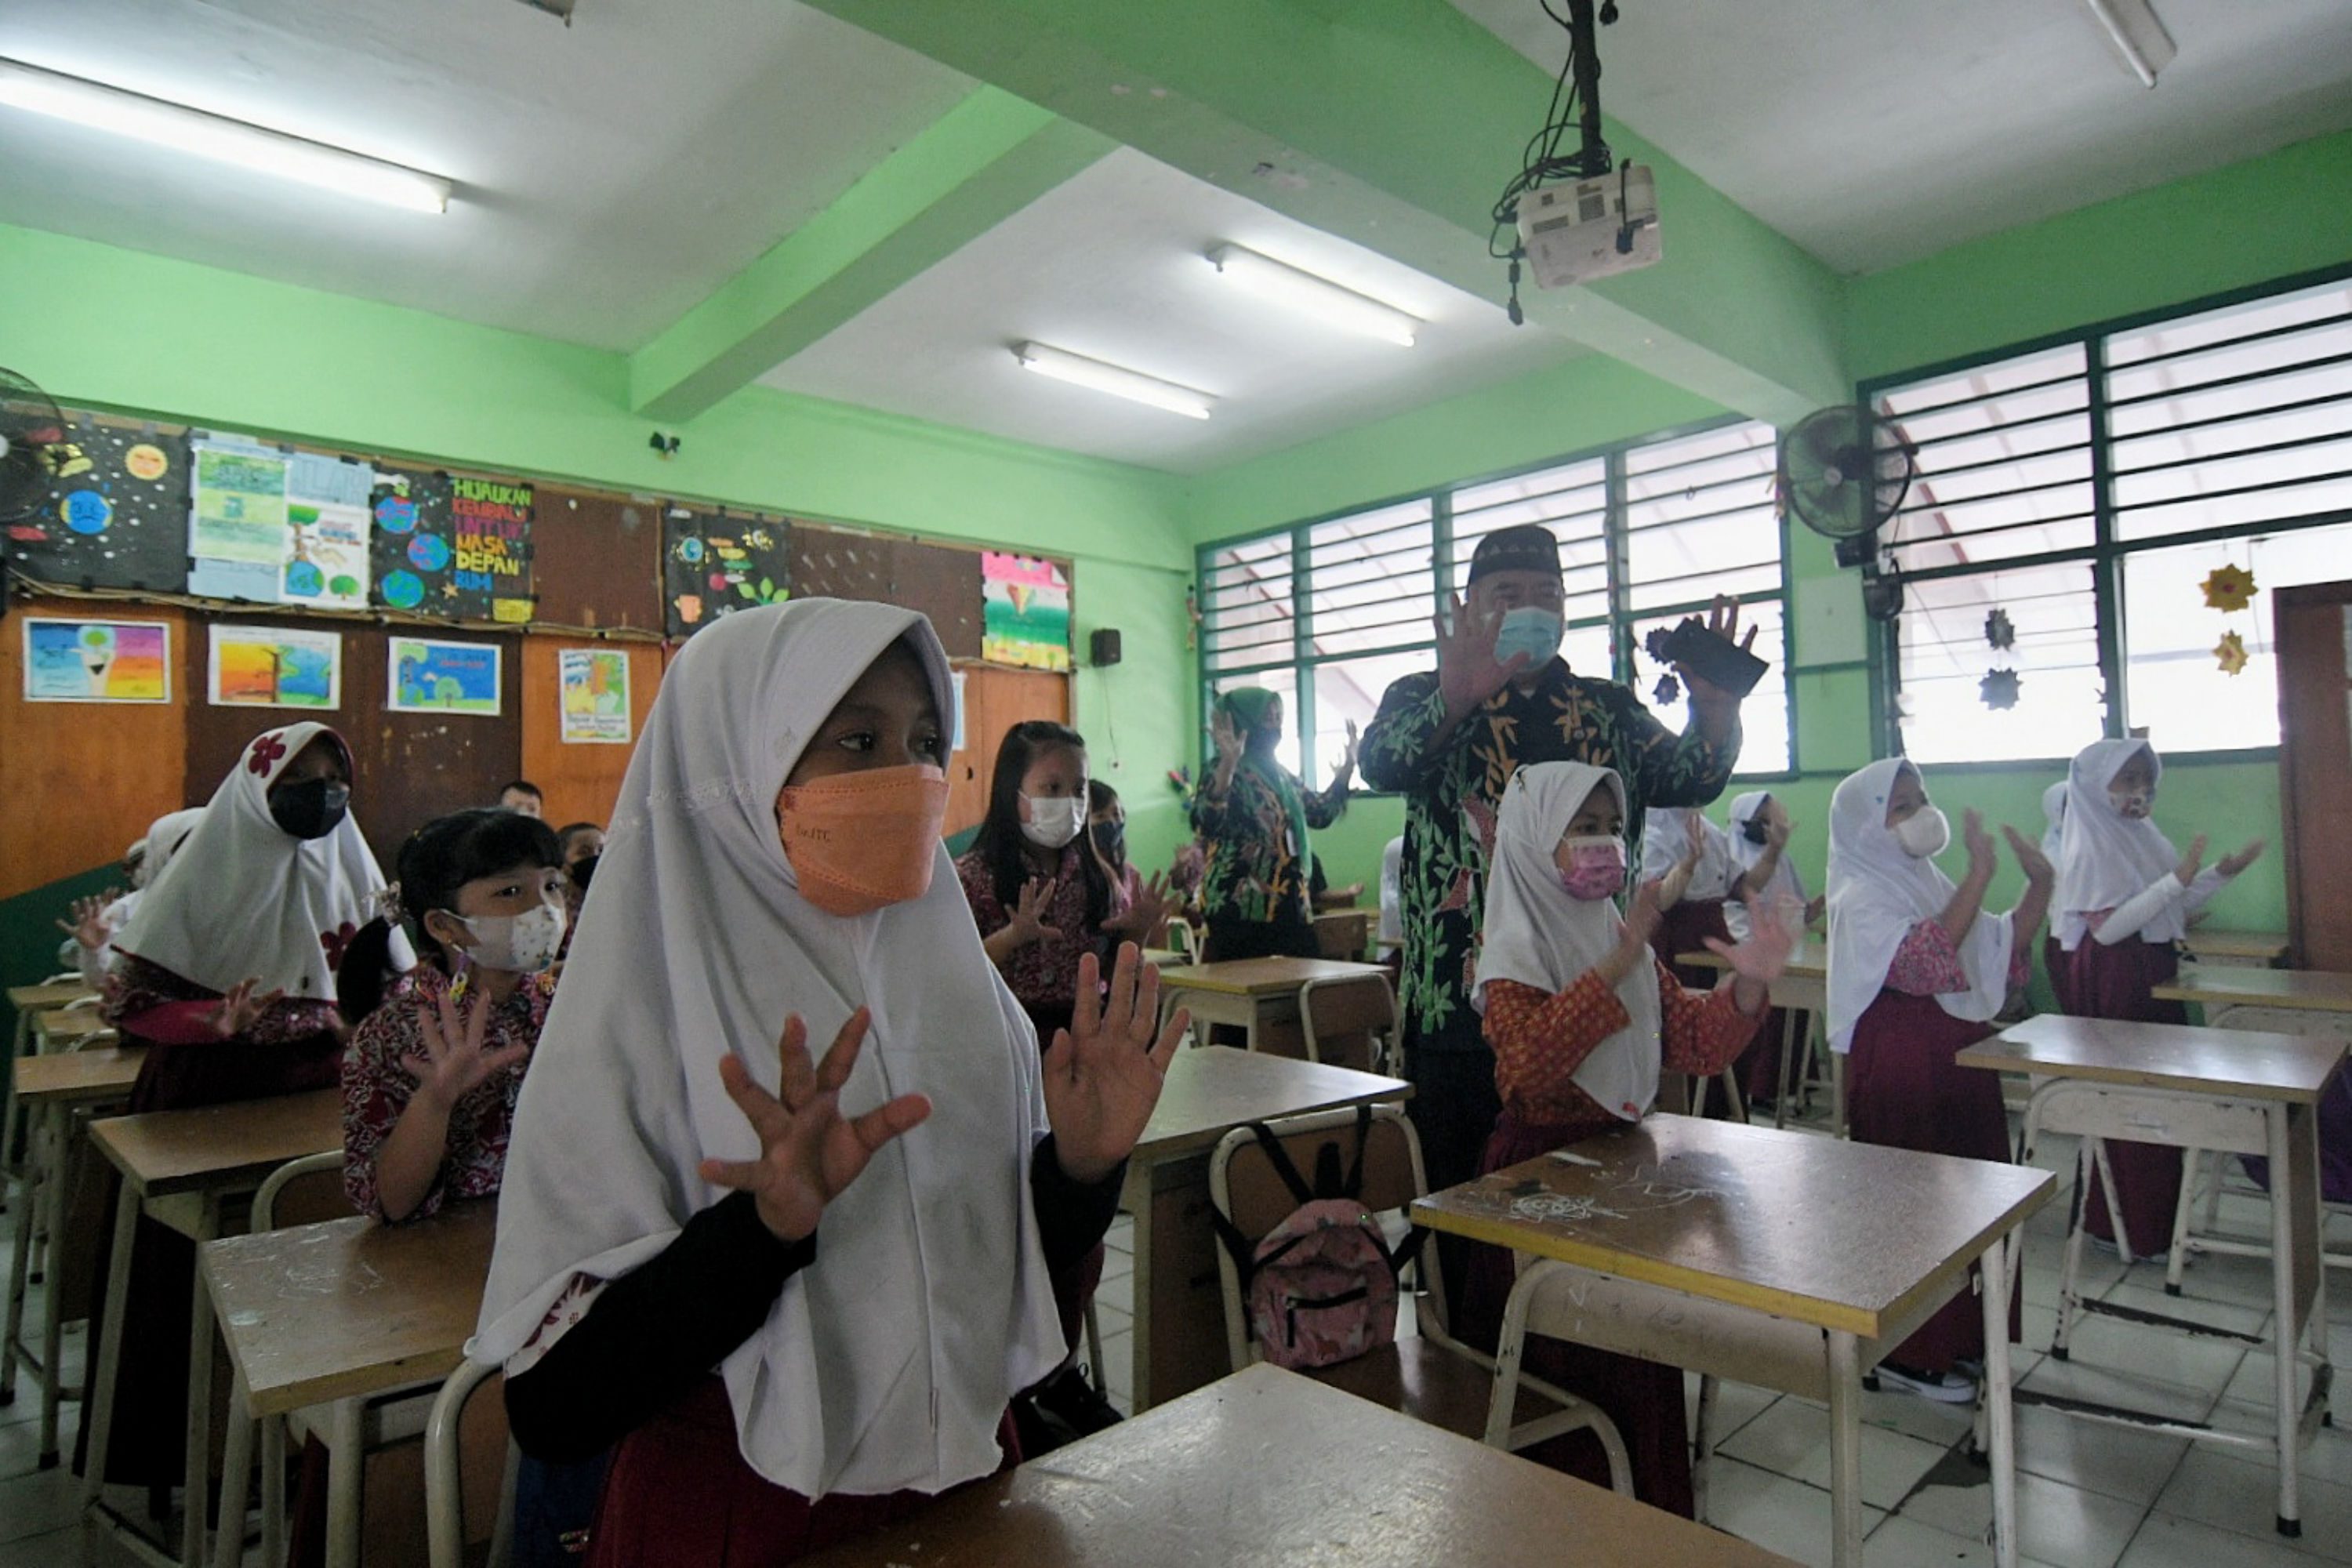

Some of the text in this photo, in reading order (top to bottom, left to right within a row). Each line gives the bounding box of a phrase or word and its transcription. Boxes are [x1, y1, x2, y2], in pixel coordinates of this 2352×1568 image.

[454, 479, 531, 505] HIJAUKAN
[456, 534, 506, 554] MASA
[456, 550, 519, 575] DEPAN
